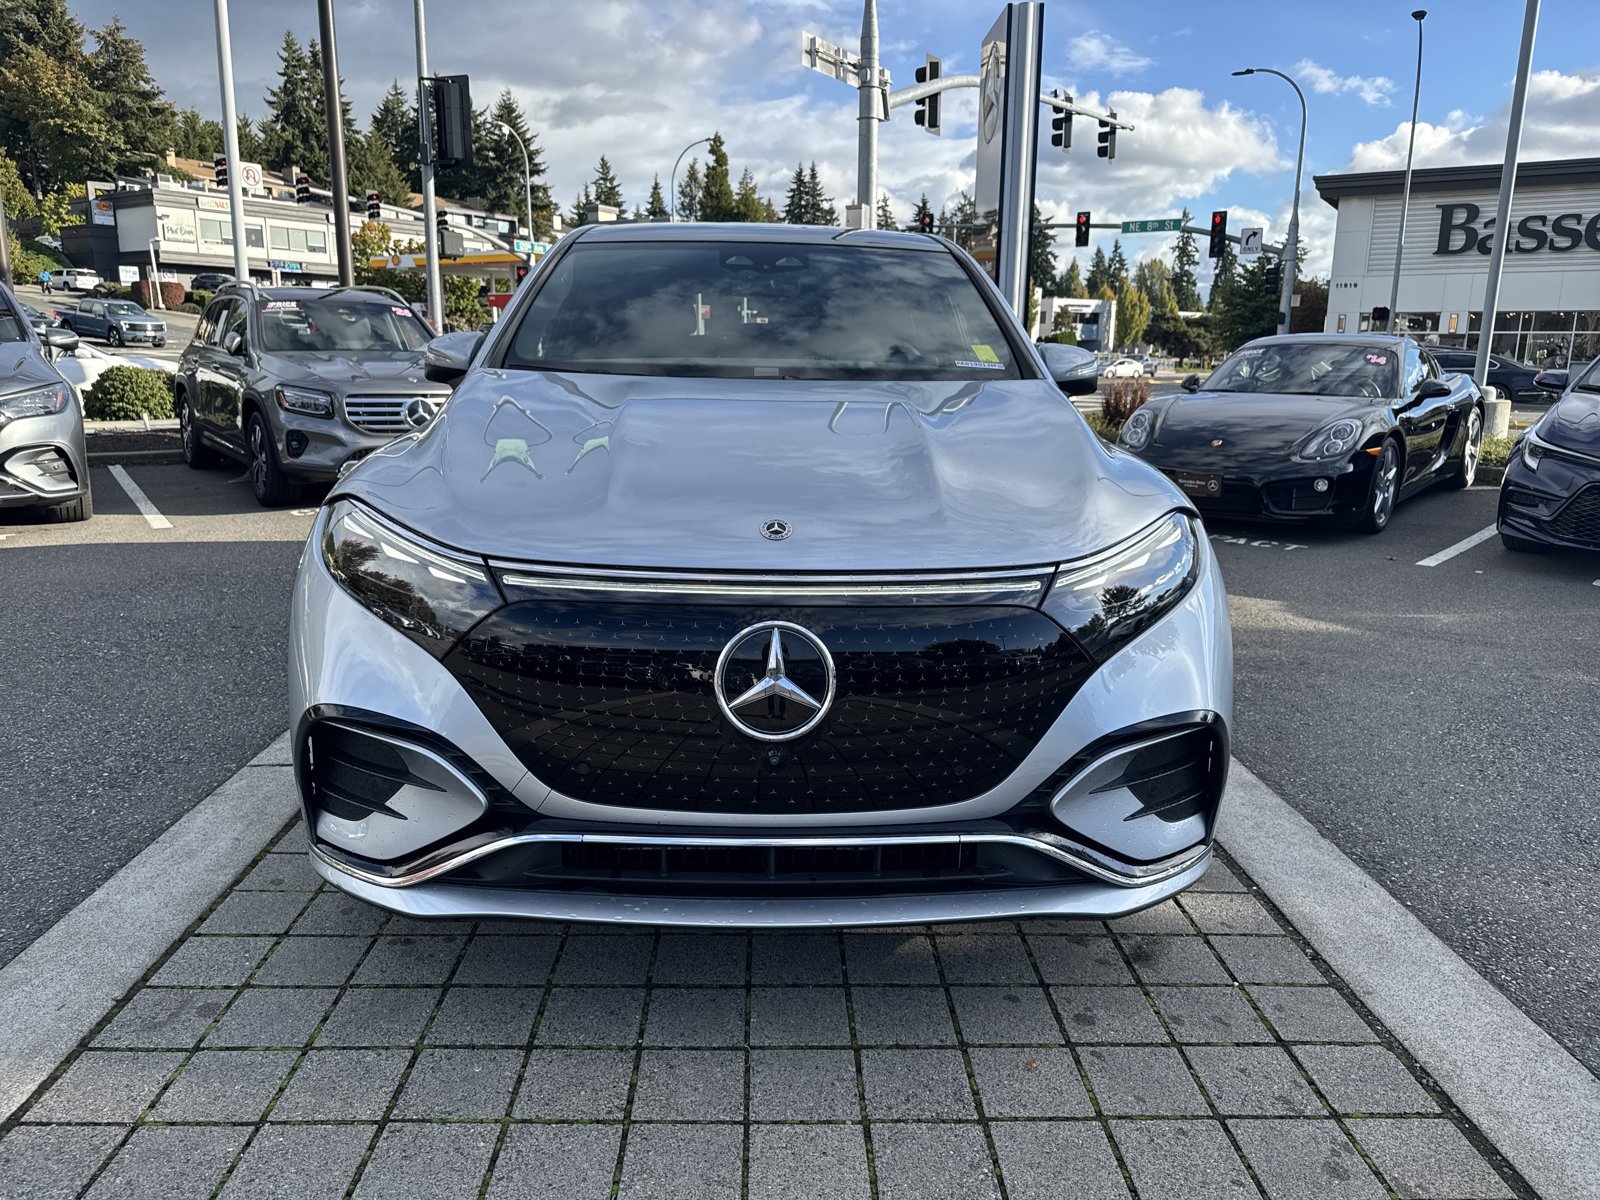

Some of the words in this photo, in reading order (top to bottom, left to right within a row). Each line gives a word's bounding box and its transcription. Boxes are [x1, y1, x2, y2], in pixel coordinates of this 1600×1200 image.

[1129, 223, 1141, 232] NE
[1147, 221, 1159, 231] 8th
[1165, 220, 1174, 231] St
